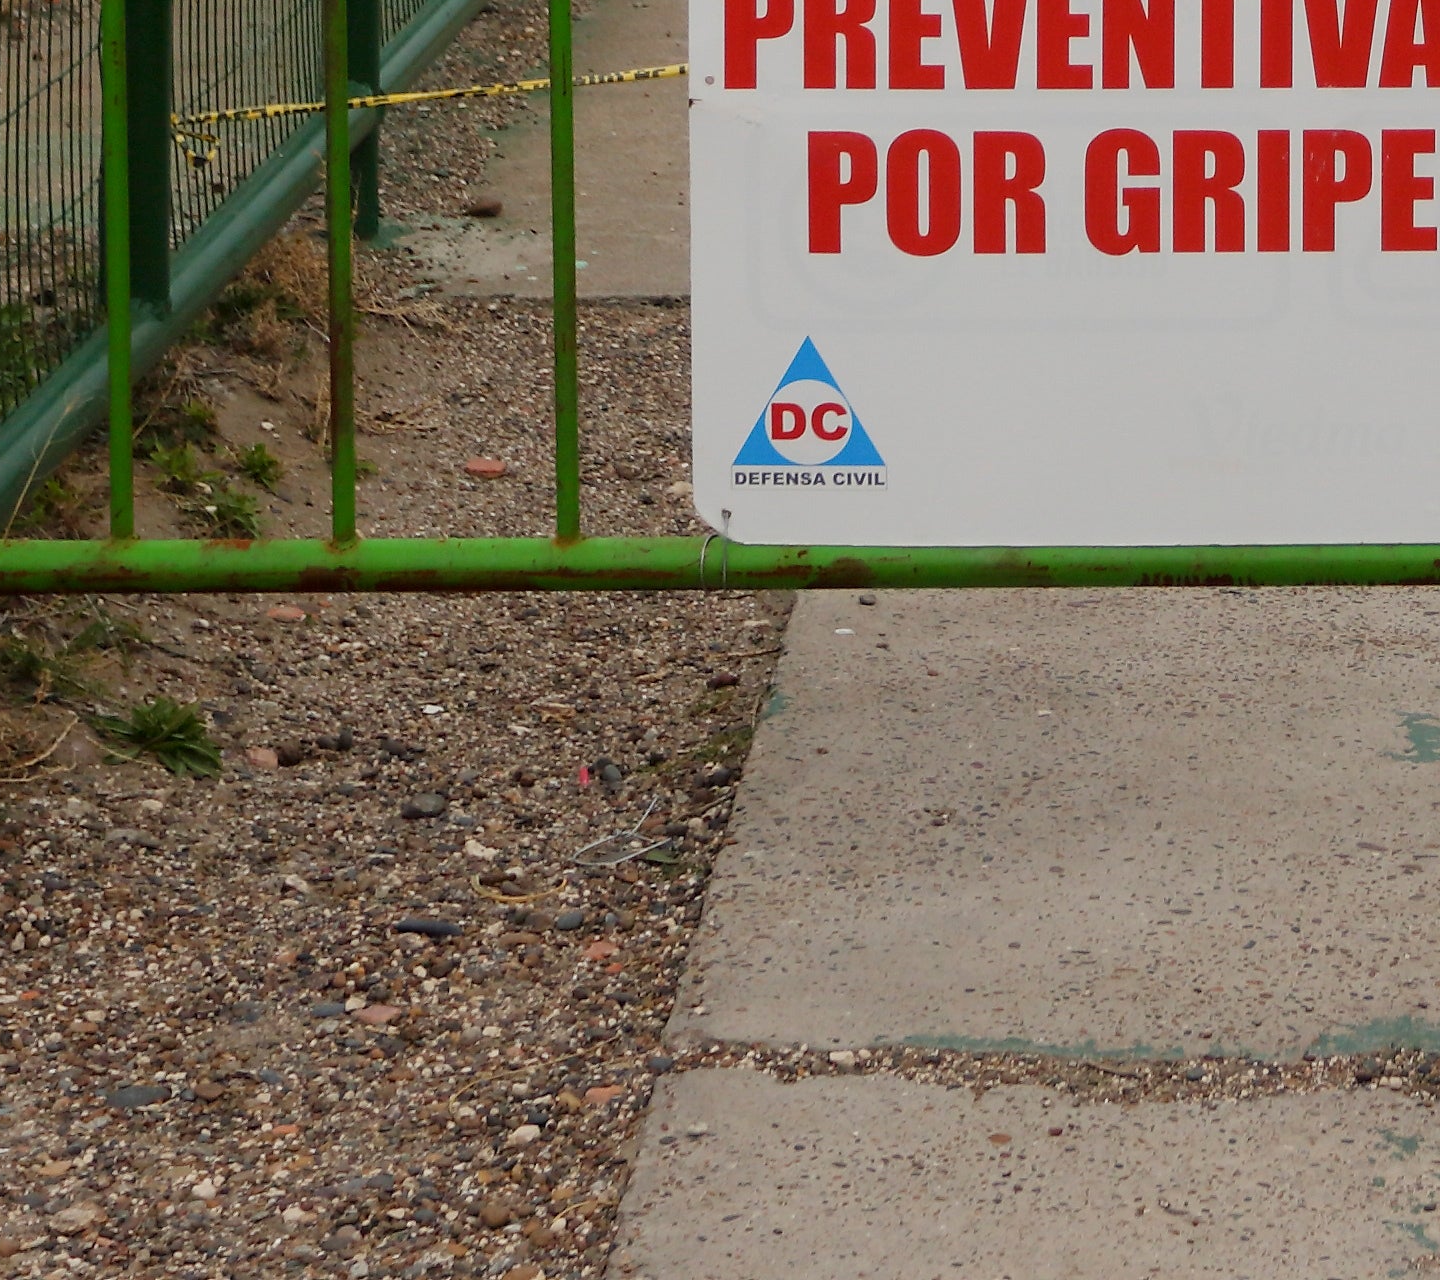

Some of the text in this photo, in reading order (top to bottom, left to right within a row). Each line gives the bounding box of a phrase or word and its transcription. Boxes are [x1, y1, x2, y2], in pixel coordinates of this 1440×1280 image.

[808, 129, 1045, 256] POR
[1085, 129, 1437, 255] GRIPE
[772, 403, 846, 440] DC
[734, 472, 885, 486] DEFENSA CIVIL
